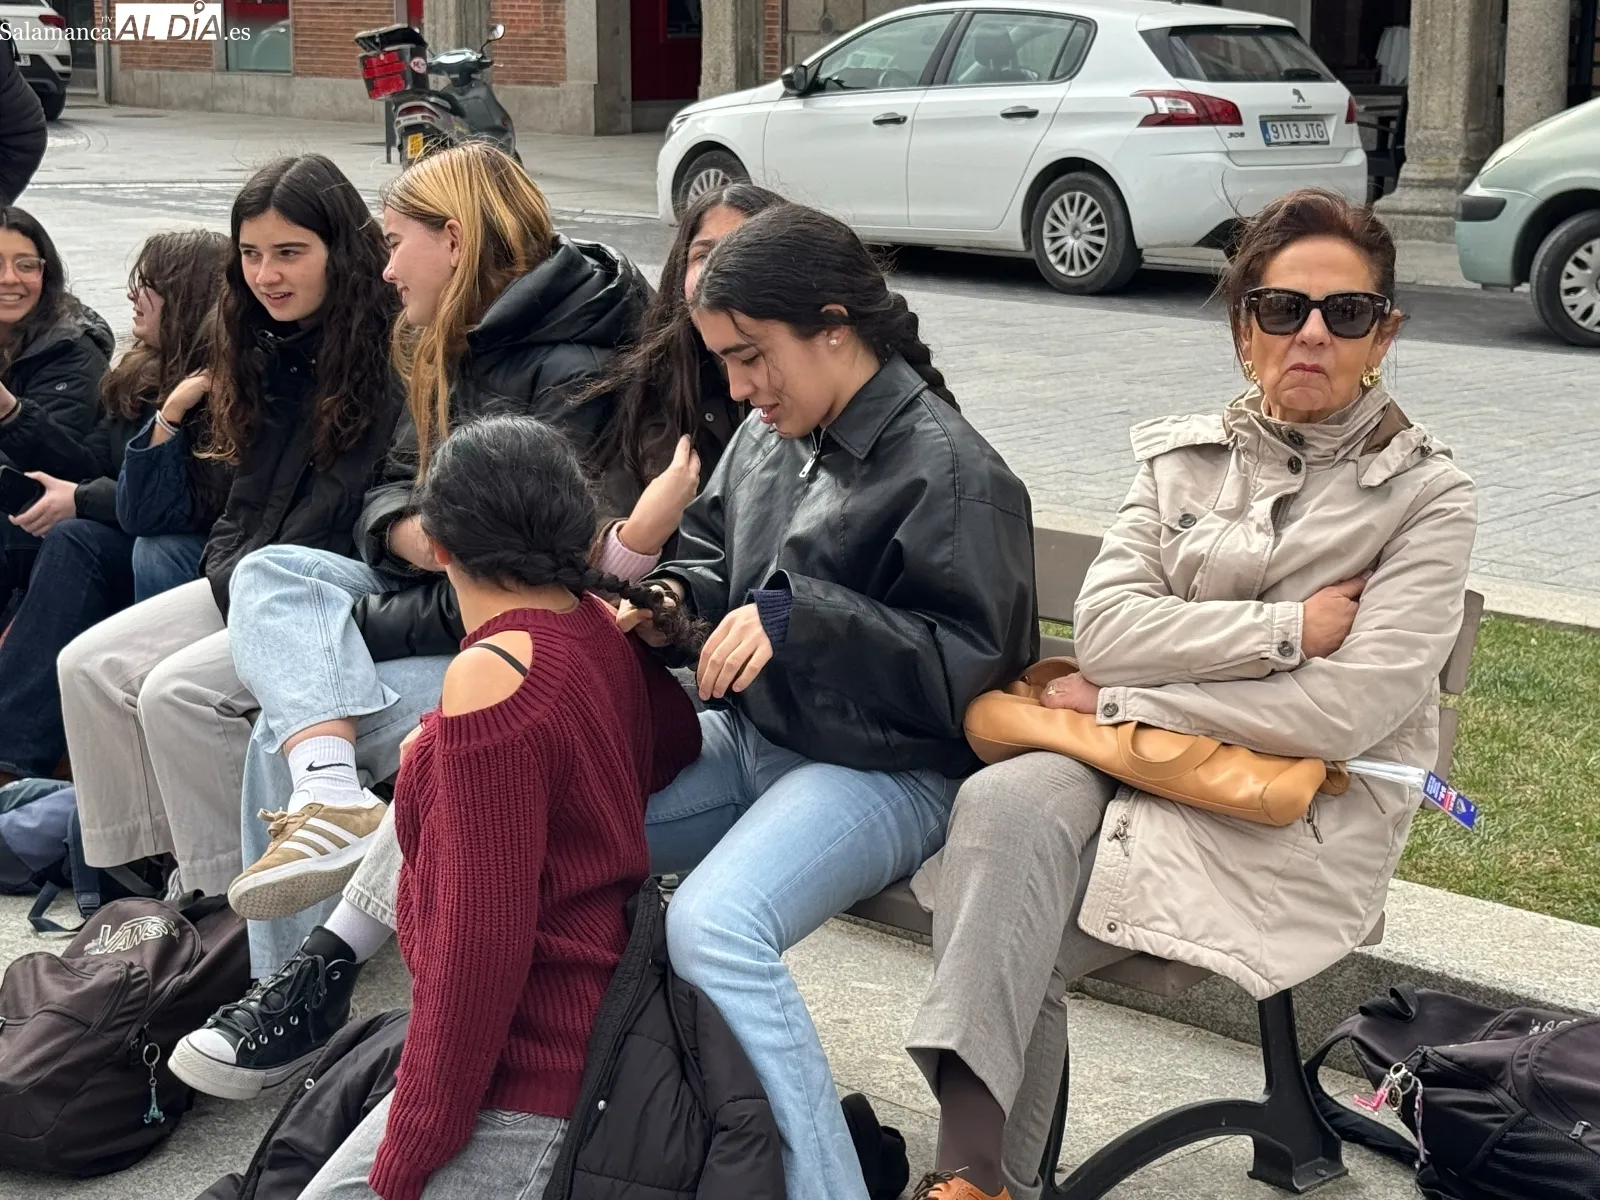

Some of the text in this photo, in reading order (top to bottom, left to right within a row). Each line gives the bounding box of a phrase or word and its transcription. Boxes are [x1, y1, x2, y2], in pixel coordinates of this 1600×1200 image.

[1227, 131, 1246, 140] 308
[1270, 122, 1326, 140] 9113 JTG
[98, 915, 172, 955] VANS
